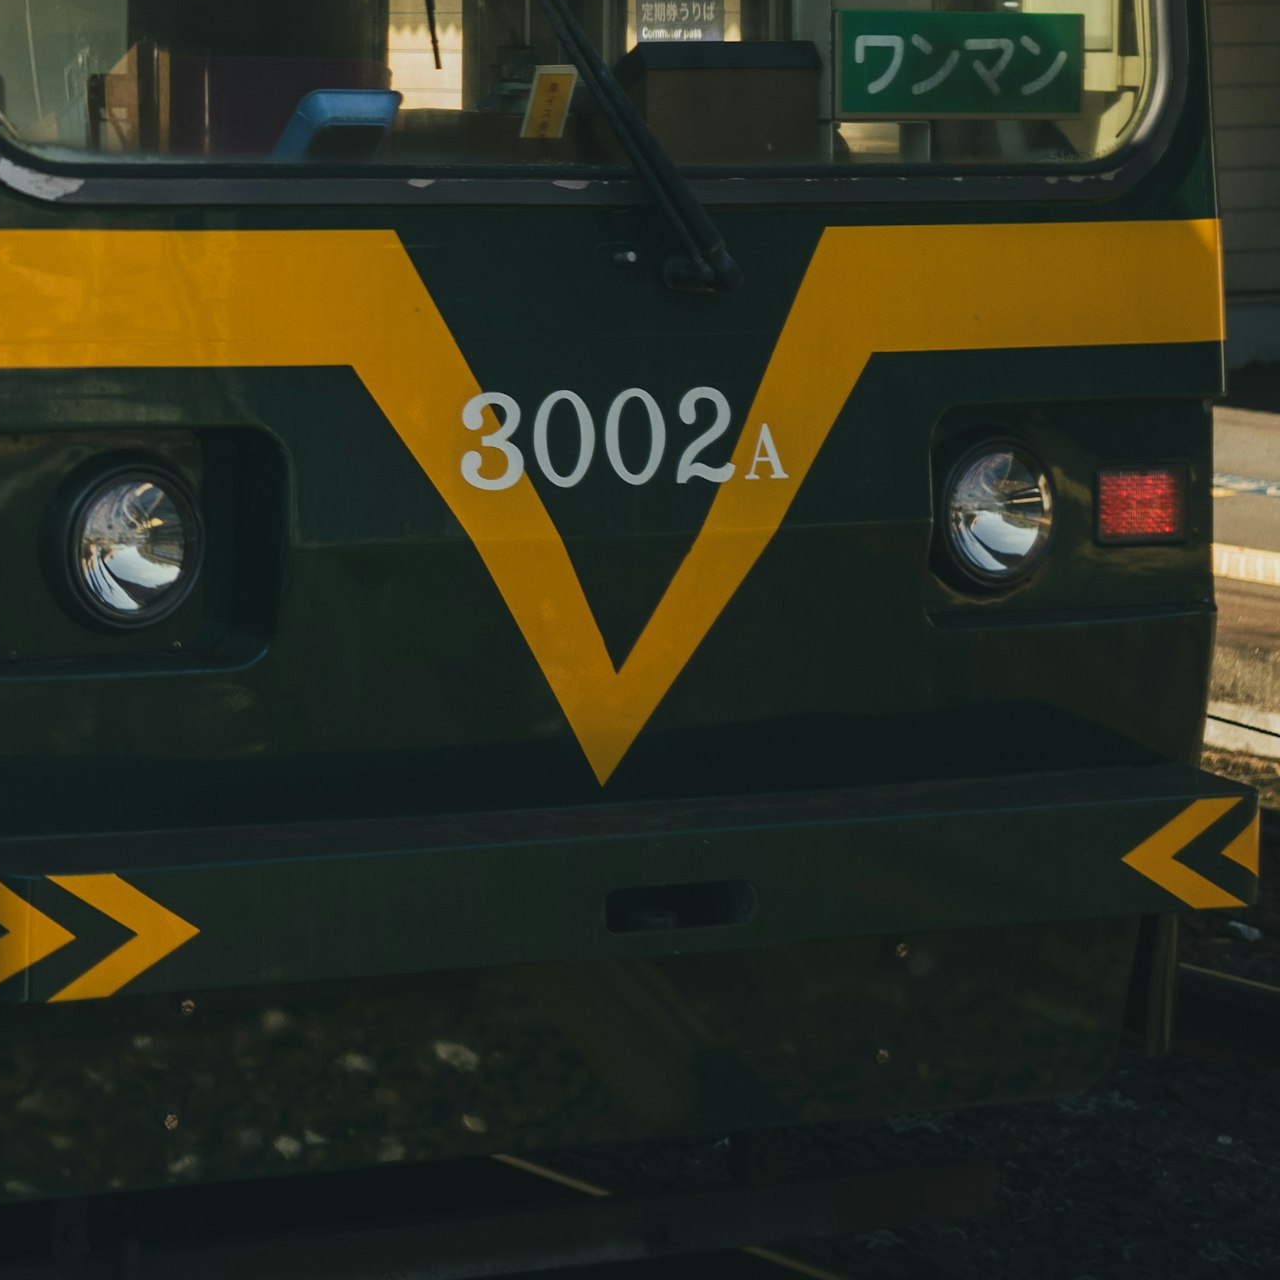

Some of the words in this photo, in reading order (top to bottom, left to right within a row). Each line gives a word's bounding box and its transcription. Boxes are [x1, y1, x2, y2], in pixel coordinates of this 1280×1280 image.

[642, 1, 715, 22] 定期券うりば
[854, 34, 1067, 95] ワンマン
[459, 385, 789, 491] 3002A
